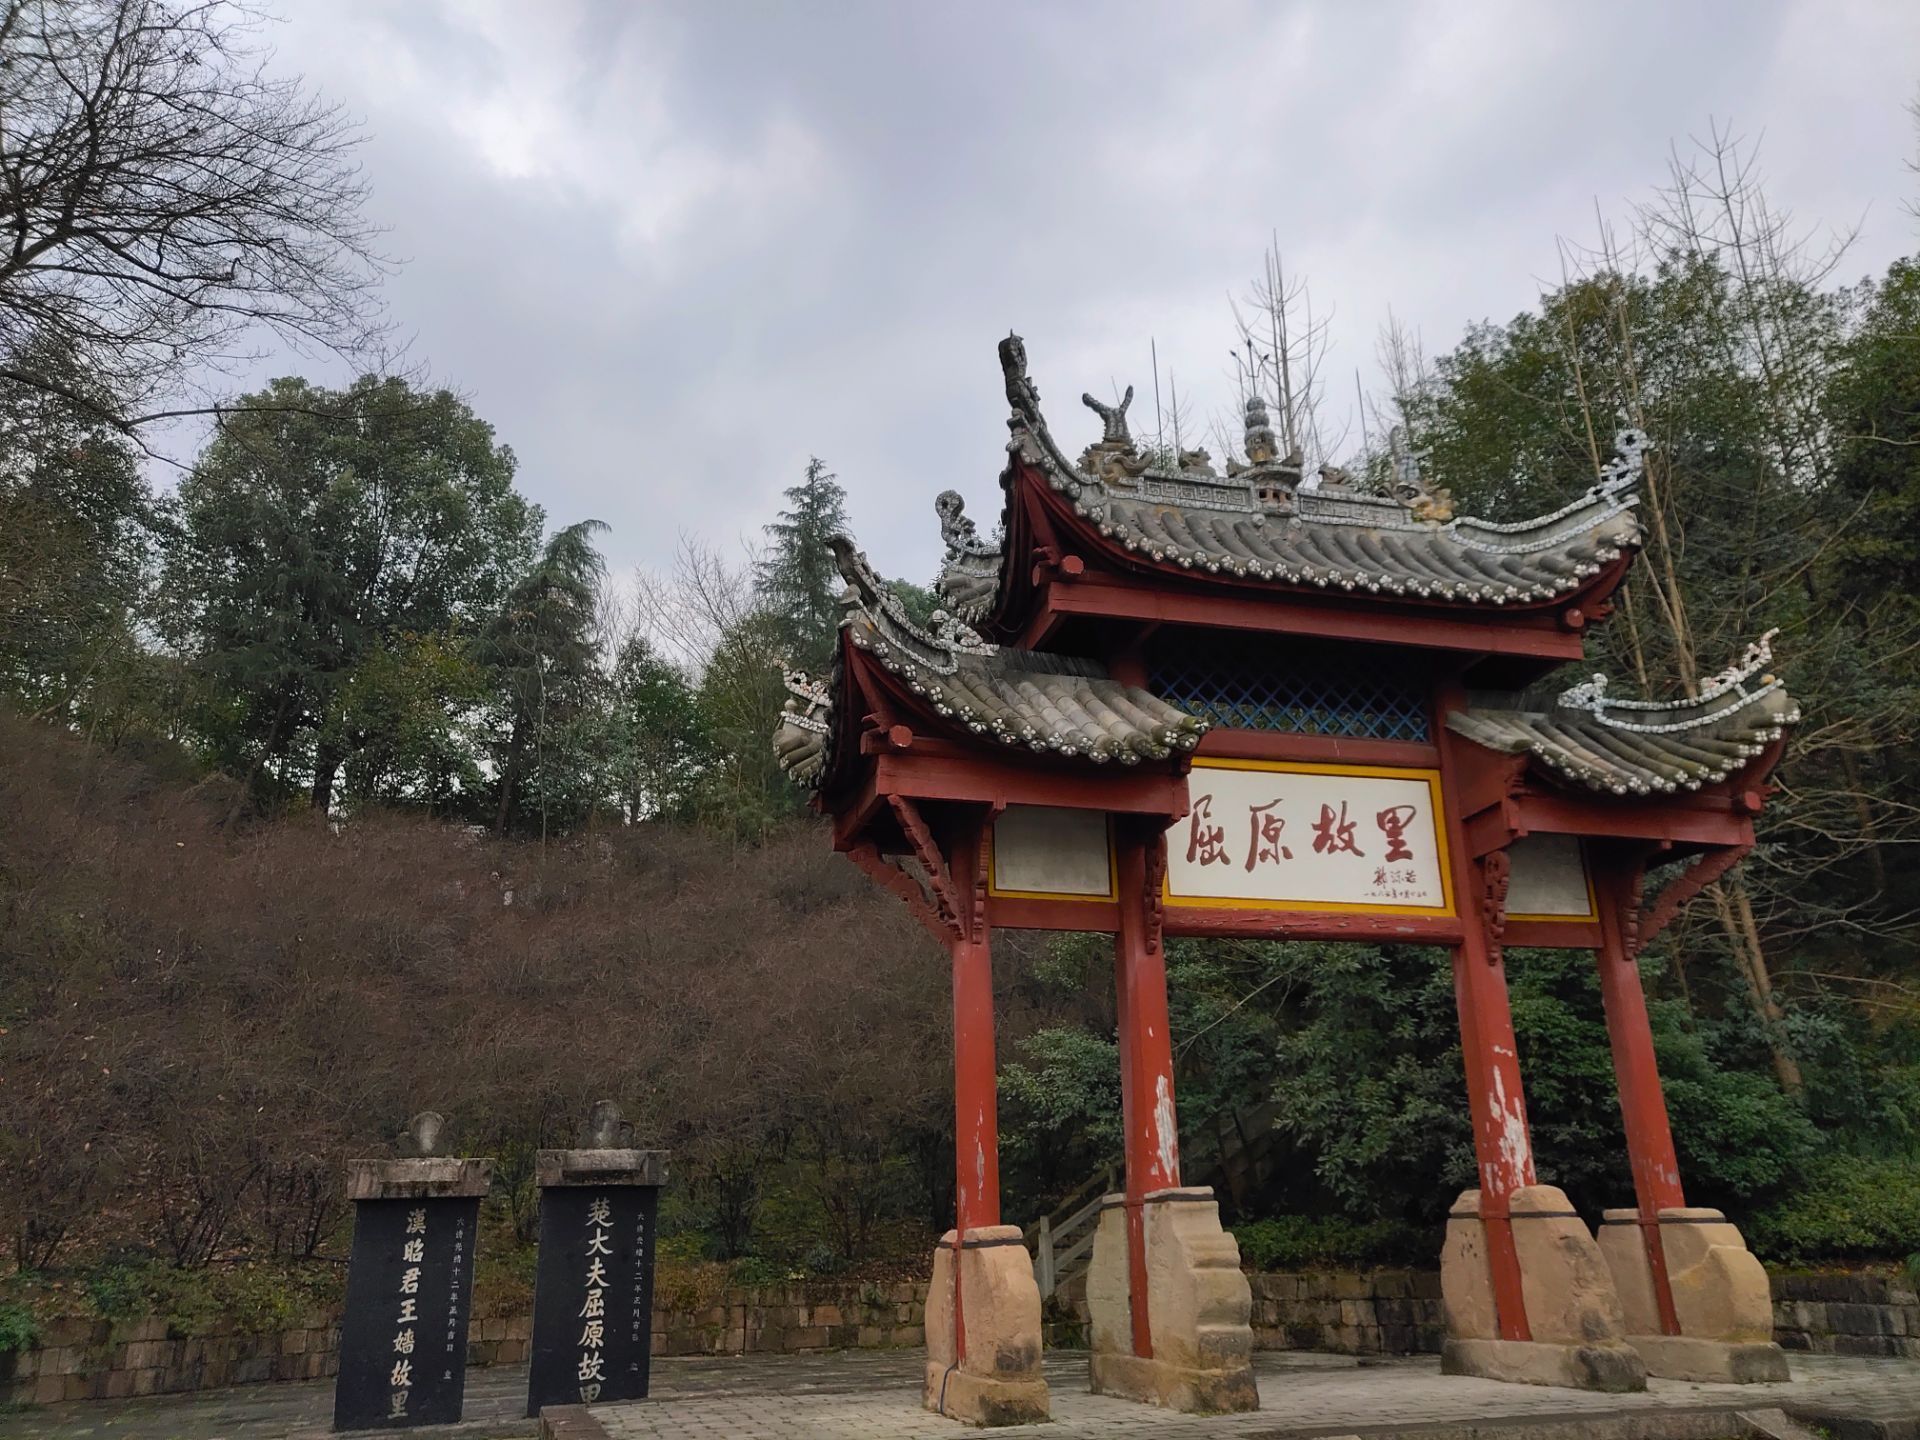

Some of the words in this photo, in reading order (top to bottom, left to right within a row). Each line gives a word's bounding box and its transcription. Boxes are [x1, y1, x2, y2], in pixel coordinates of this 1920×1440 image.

[1186, 794, 1416, 873] 屈原故里
[387, 1207, 427, 1419] 漢昭君王嬙故里
[577, 1197, 615, 1407] 楚大夫屈原故里
